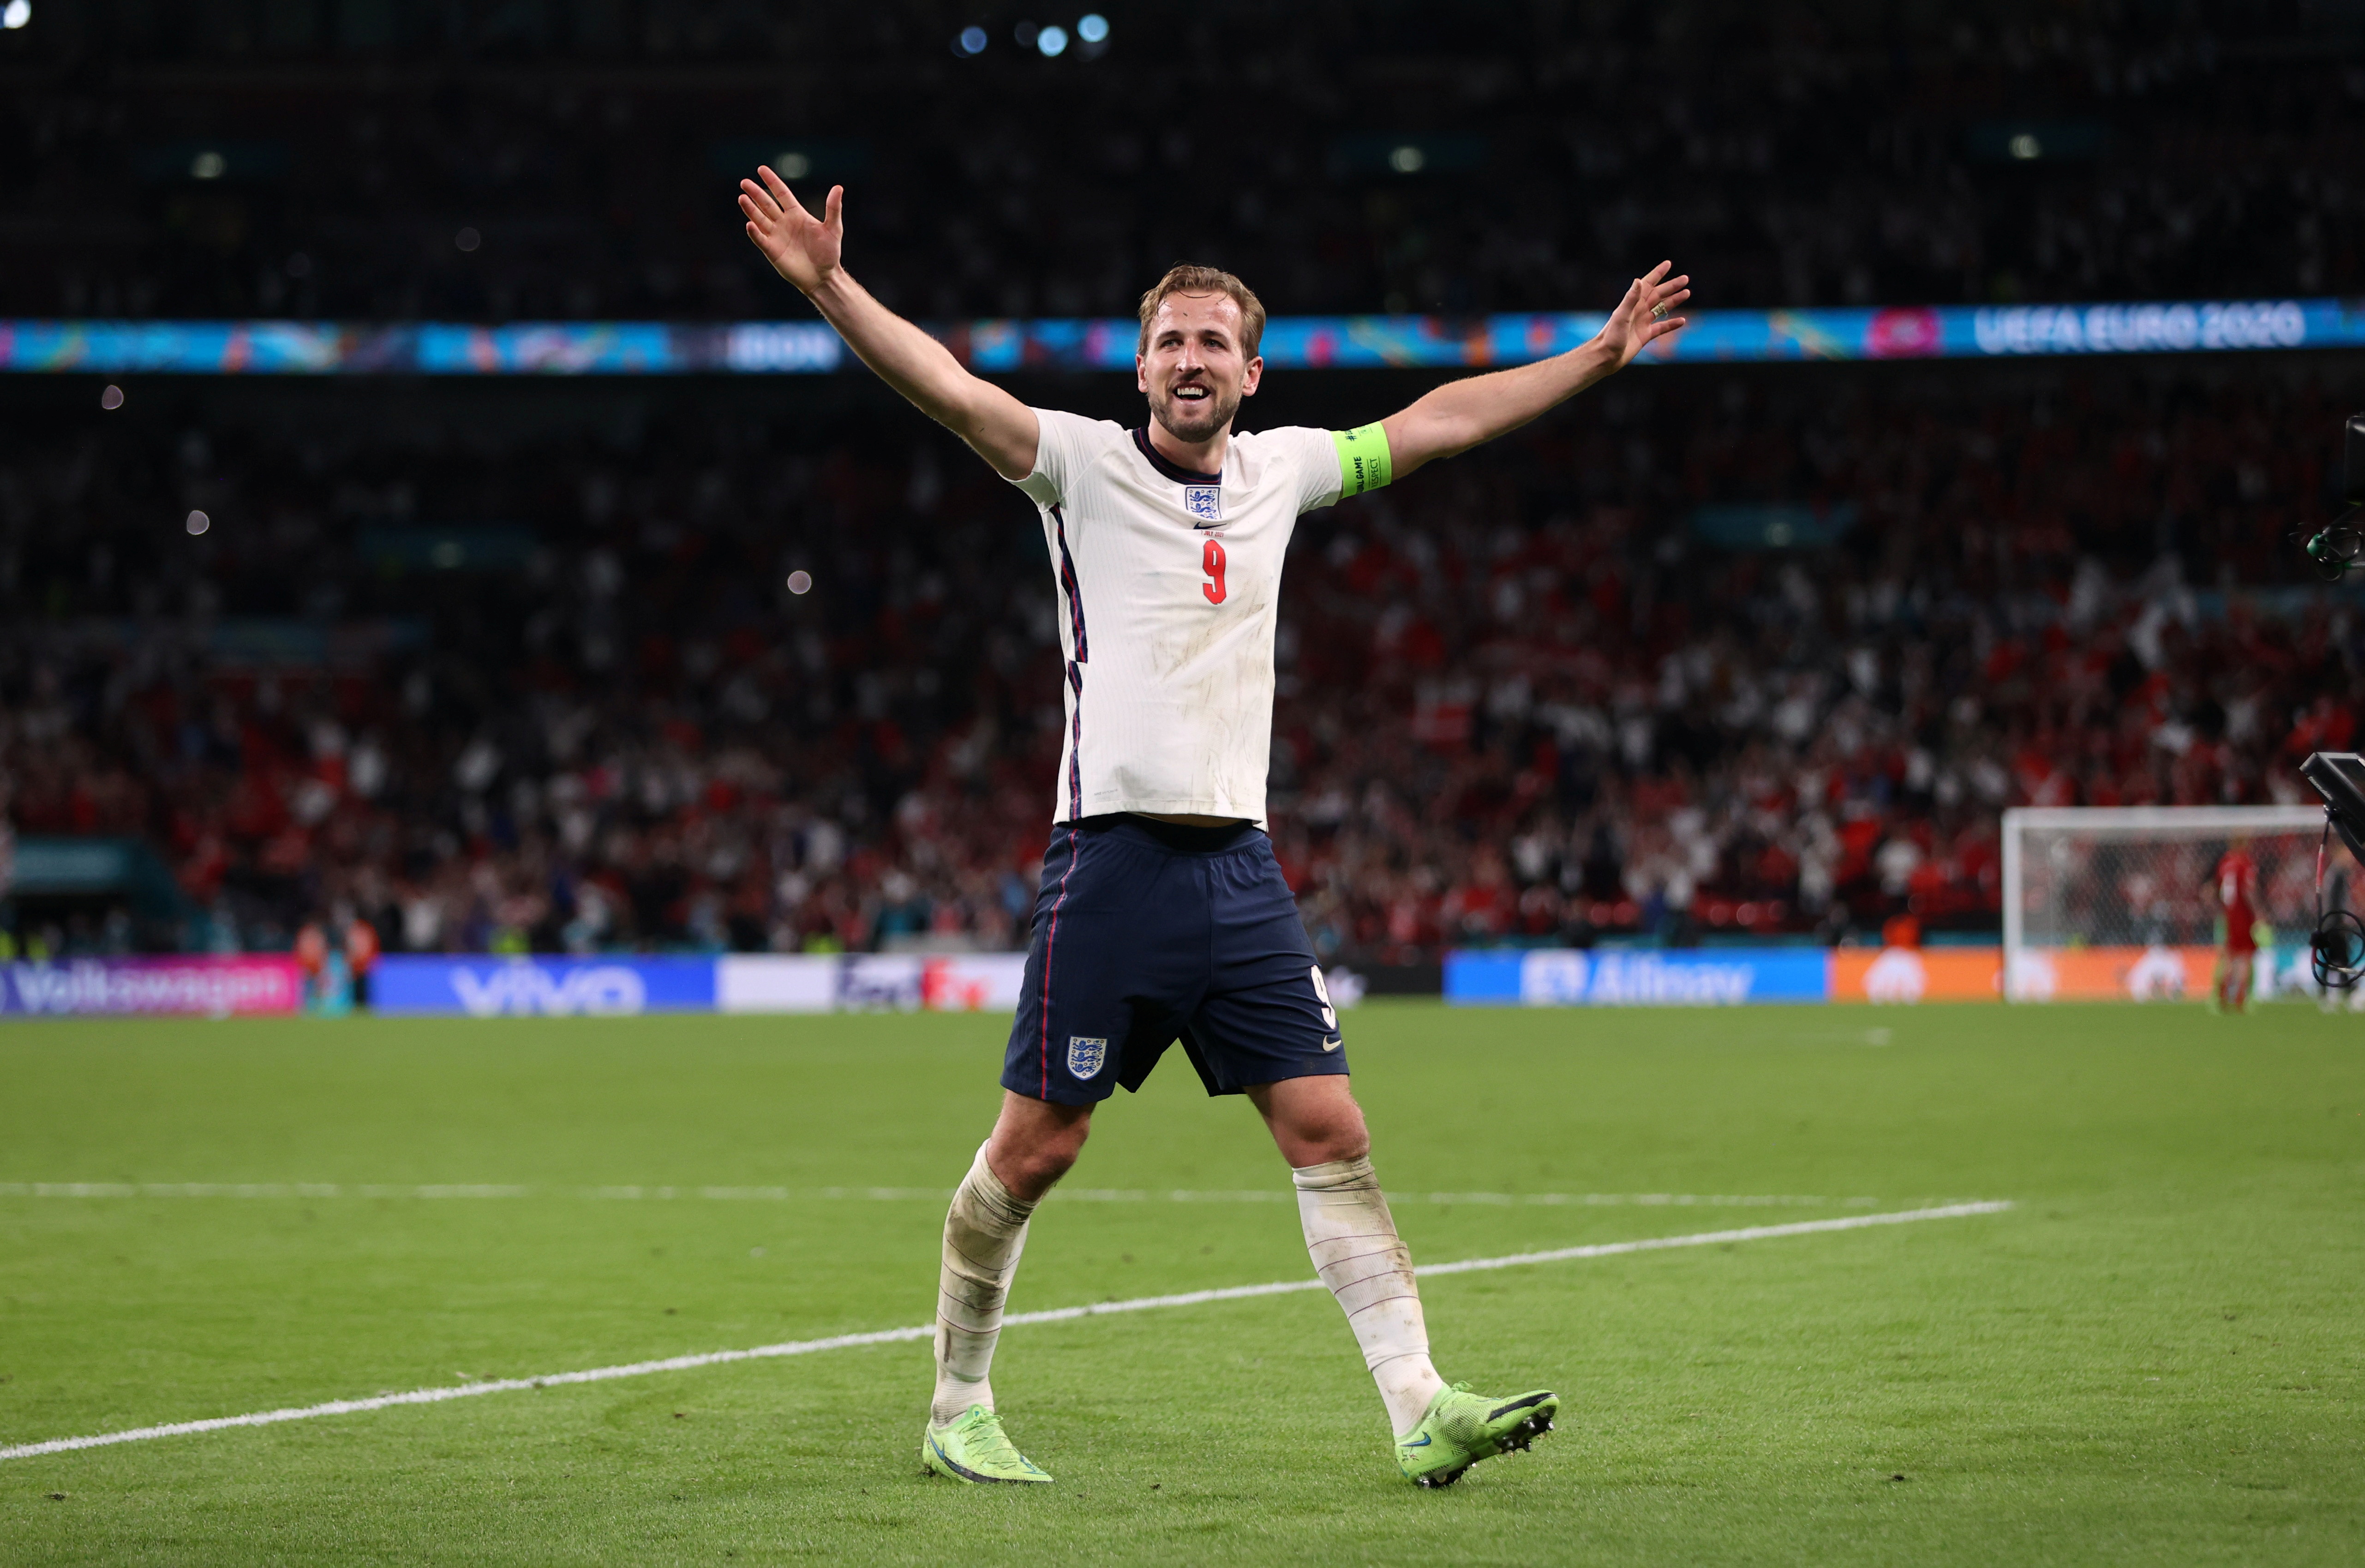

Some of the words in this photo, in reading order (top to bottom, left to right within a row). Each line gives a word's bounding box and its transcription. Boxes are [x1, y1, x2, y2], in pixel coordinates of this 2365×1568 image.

[1975, 306, 2083, 354] UEFA
[2086, 304, 2197, 352] EURO
[2200, 301, 2305, 349] 2020
[1202, 539, 1227, 605] 9
[1311, 964, 1336, 1029] 9
